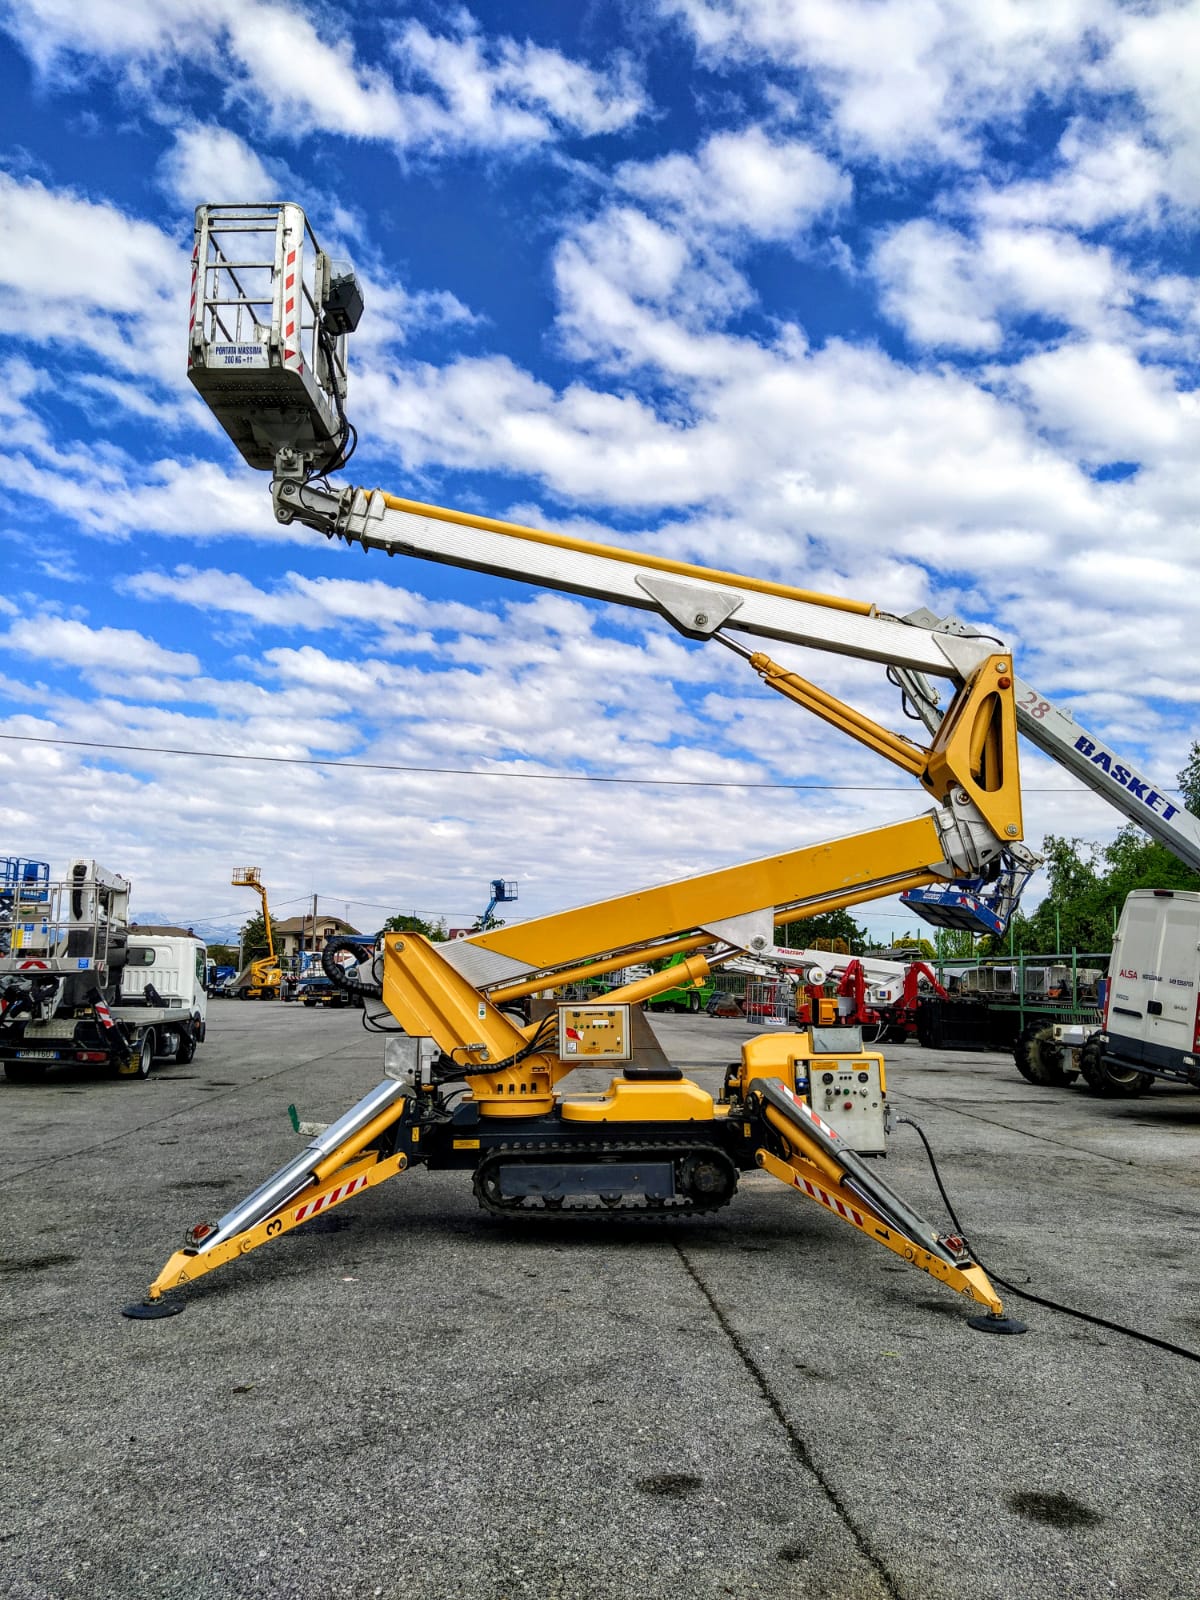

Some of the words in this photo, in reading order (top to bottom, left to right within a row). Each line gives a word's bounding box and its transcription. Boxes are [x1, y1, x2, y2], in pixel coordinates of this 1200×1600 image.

[215, 346, 236, 355] PORTATA
[238, 346, 262, 355] MASSIMA
[224, 356, 234, 364] 200
[1016, 691, 1051, 719] 28
[1073, 735, 1181, 821] BASKET
[1119, 969, 1137, 979] ALSA
[266, 1219, 282, 1236] 3
[875, 1229, 890, 1240] 1
